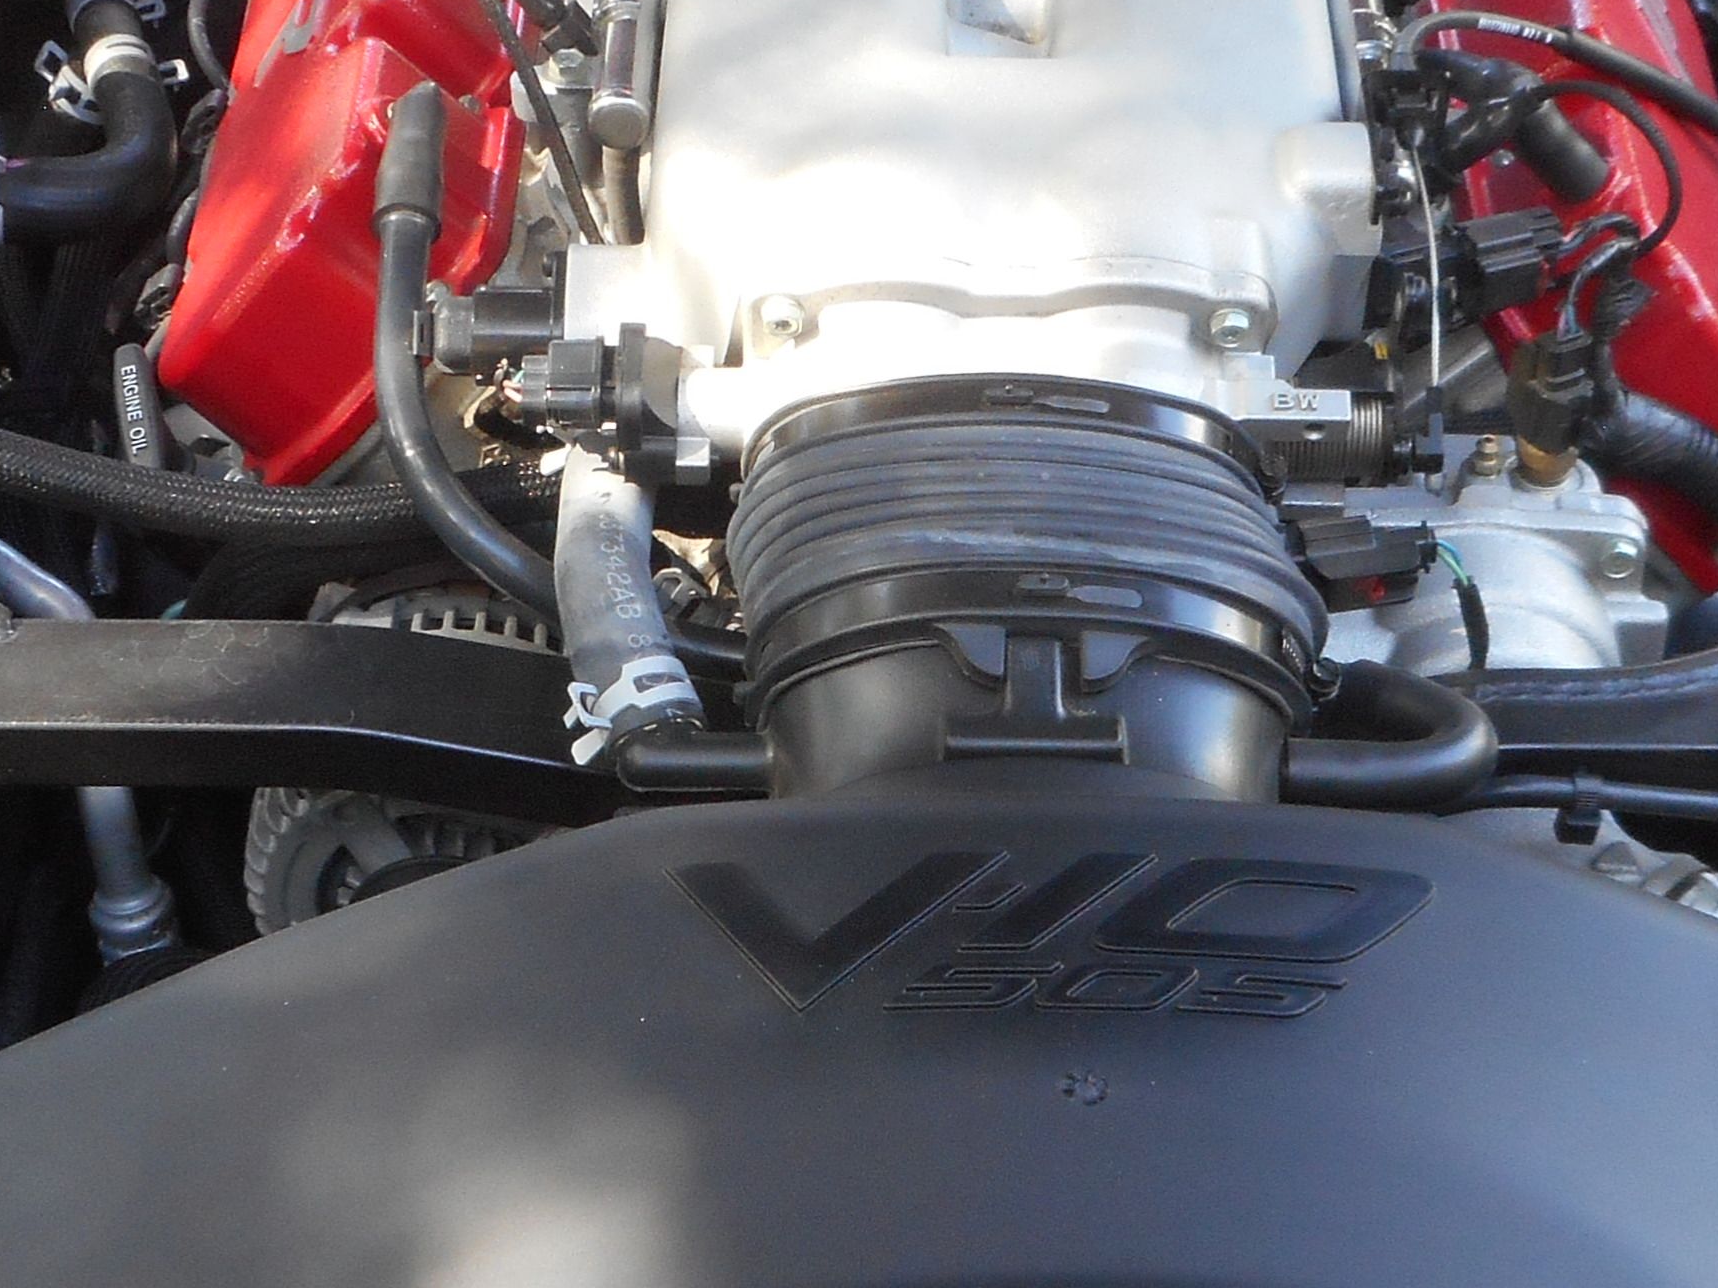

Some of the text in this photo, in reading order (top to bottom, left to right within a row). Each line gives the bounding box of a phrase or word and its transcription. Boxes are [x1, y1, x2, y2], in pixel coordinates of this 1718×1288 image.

[120, 364, 148, 454] ENGINE OIL
[1271, 390, 1320, 412] BW
[664, 849, 1436, 1016] V10
[883, 961, 1349, 1020] 505
